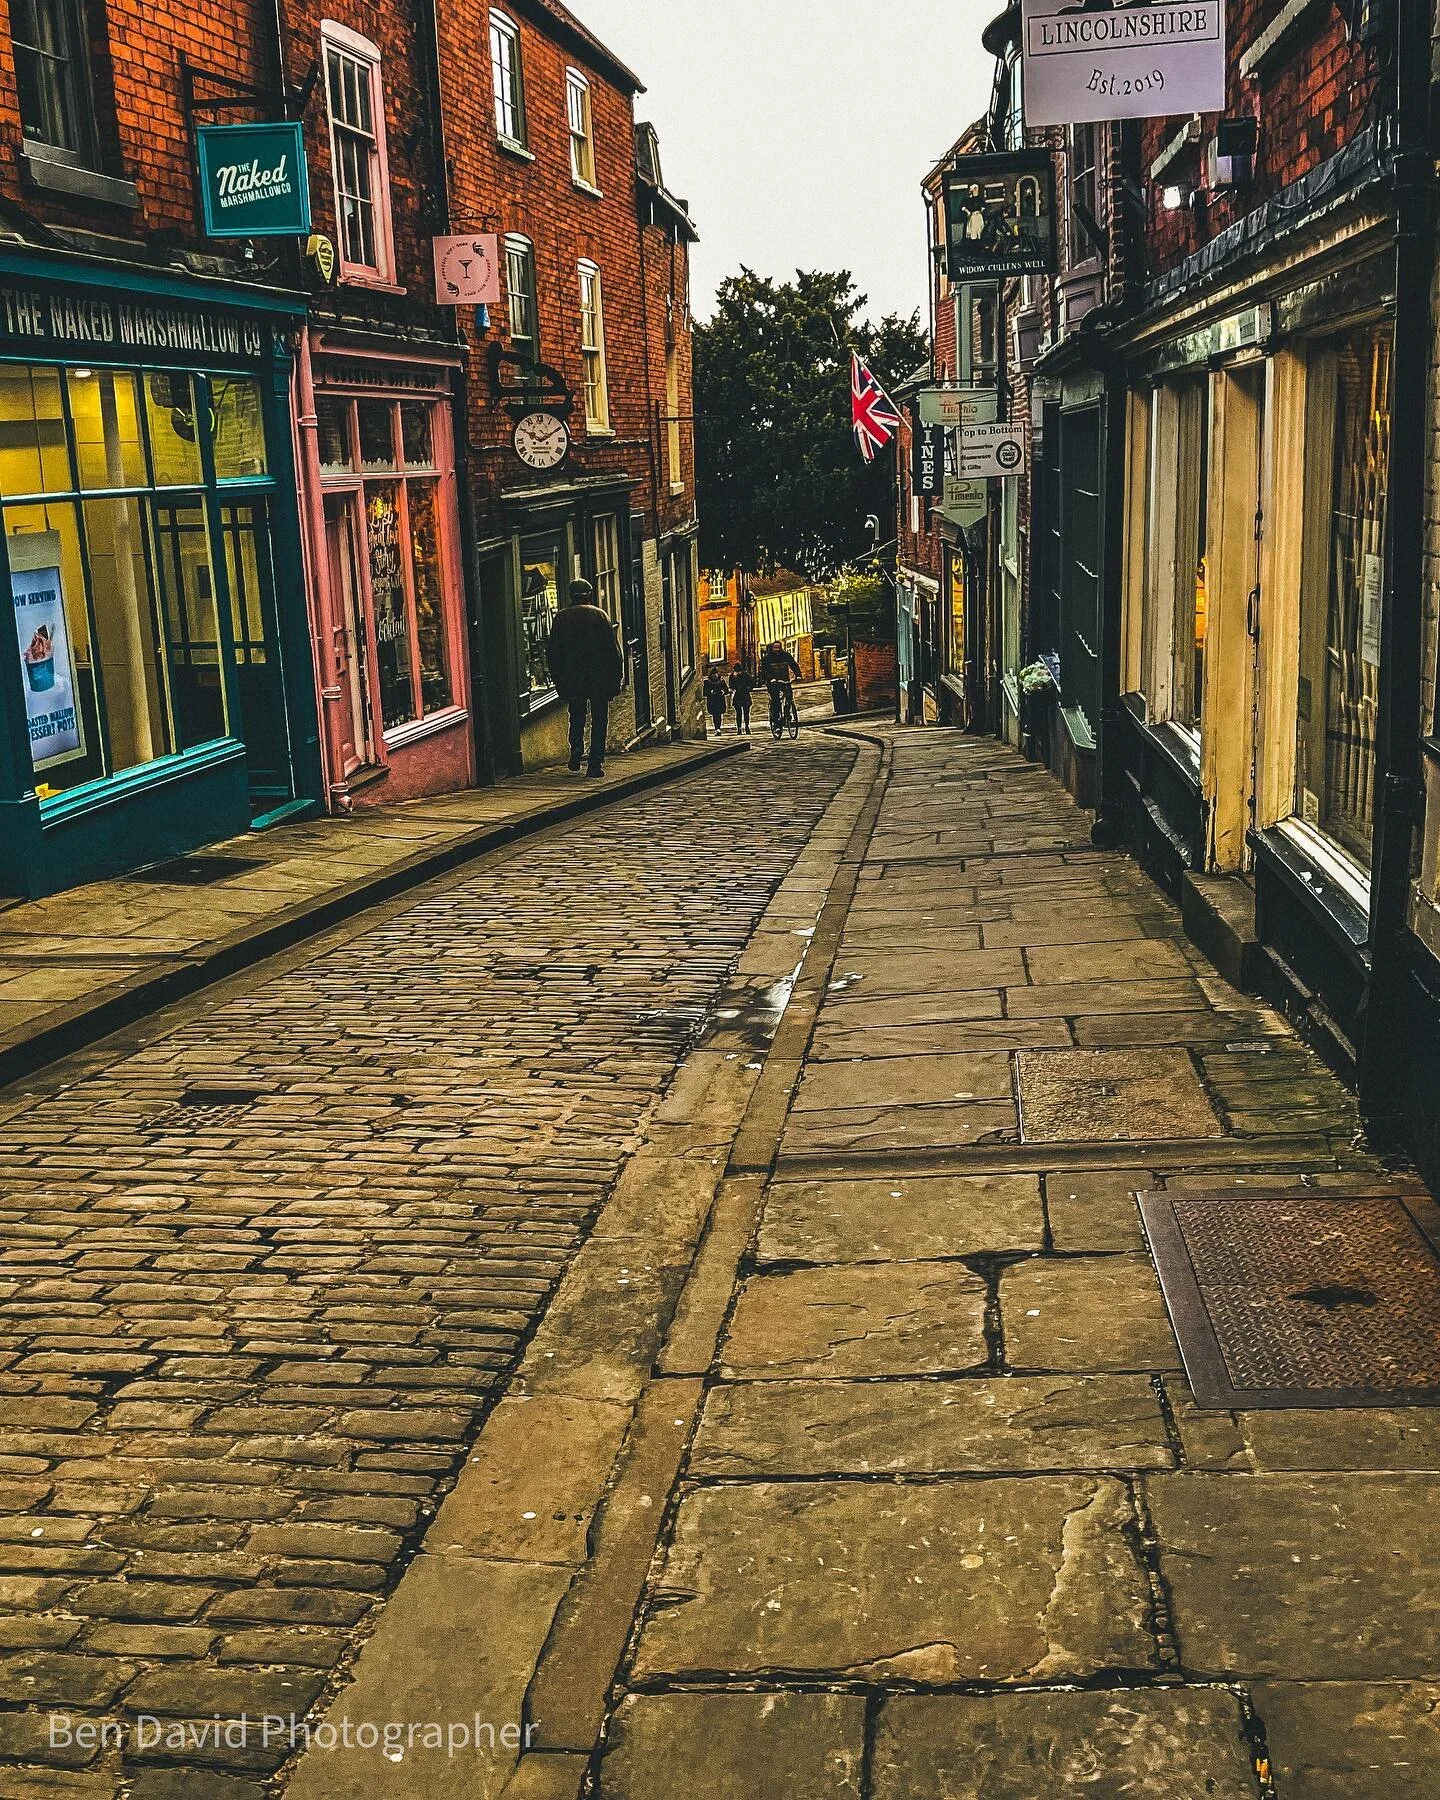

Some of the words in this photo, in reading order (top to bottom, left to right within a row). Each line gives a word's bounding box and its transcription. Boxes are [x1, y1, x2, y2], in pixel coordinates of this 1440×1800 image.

[1041, 9, 1207, 46] LINCOLNSHIRE
[216, 154, 287, 196] Naked
[238, 162, 251, 173] THE
[959, 264, 986, 275] WIDOW
[1024, 259, 1046, 268] WELL
[1, 288, 45, 336] THE
[49, 295, 114, 342] NAKED
[118, 304, 240, 354] MARSHMALLOW
[244, 319, 262, 356] CO
[958, 427, 976, 438] Top
[978, 428, 987, 436] to
[989, 425, 1022, 436] Bottom
[14, 593, 27, 607] OW
[28, 590, 57, 605] SERVING
[27, 714, 49, 729] OASTED
[31, 725, 56, 741] ESSERT
[57, 717, 75, 733] POTS
